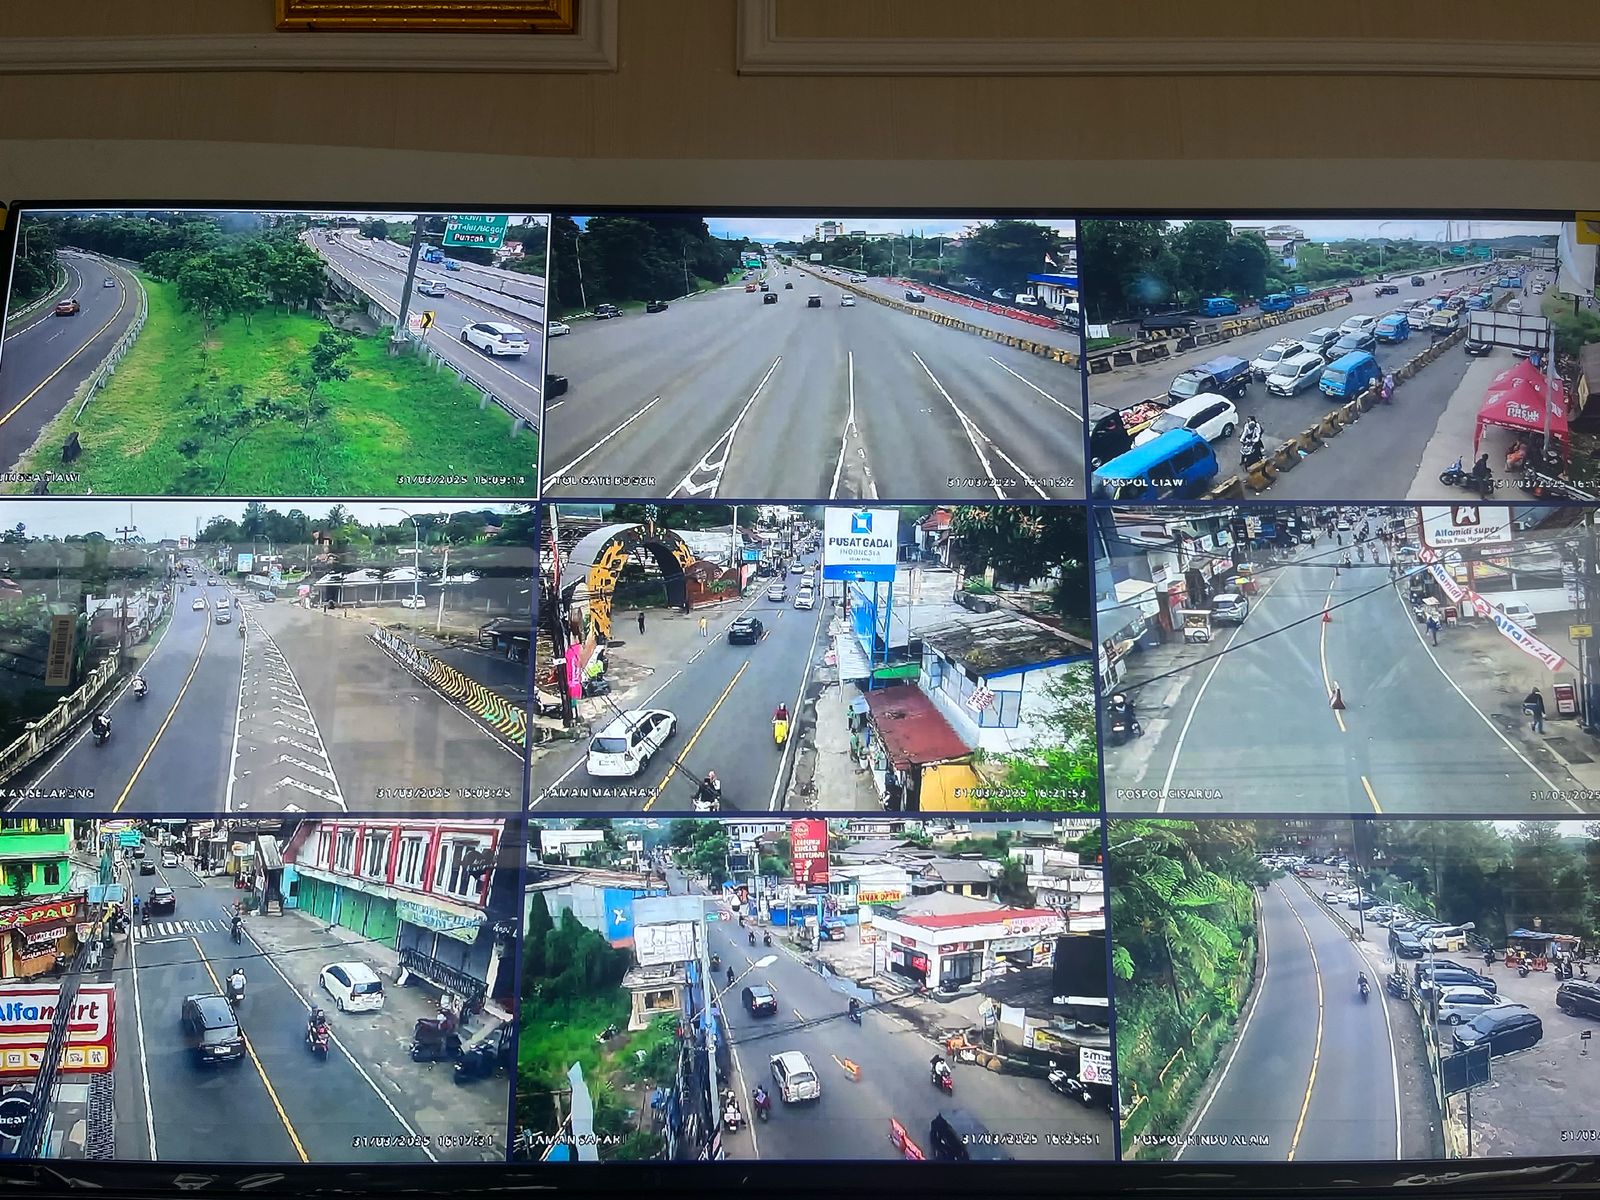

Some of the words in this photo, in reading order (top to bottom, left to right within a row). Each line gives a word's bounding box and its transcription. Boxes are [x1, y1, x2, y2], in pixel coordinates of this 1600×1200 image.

[398, 475, 468, 485] 31/03/2025
[580, 476, 611, 486] GATE
[947, 478, 1016, 488] 31/03/2025
[1434, 527, 1472, 537] Alfamidi
[1474, 525, 1500, 535] super
[828, 537, 862, 547] PUSAT
[862, 538, 893, 548] GADAI
[1431, 563, 1463, 600] Alfamidi
[1493, 614, 1557, 668] Alfamidi
[377, 788, 451, 798] 31/03/2025
[544, 788, 589, 798] TAMAN
[954, 788, 1026, 798] 31/03/2025
[1034, 788, 1086, 798] 16:21:53
[1117, 789, 1165, 799] POSPOL
[1168, 789, 1223, 799] CISARUA
[1530, 791, 1600, 800] 31/03/2025
[352, 1136, 431, 1147] 31/03/2025
[962, 1134, 1038, 1144] 31/03/2025
[1045, 1134, 1100, 1144] 16:25:51
[1231, 1135, 1269, 1145] ALAM
